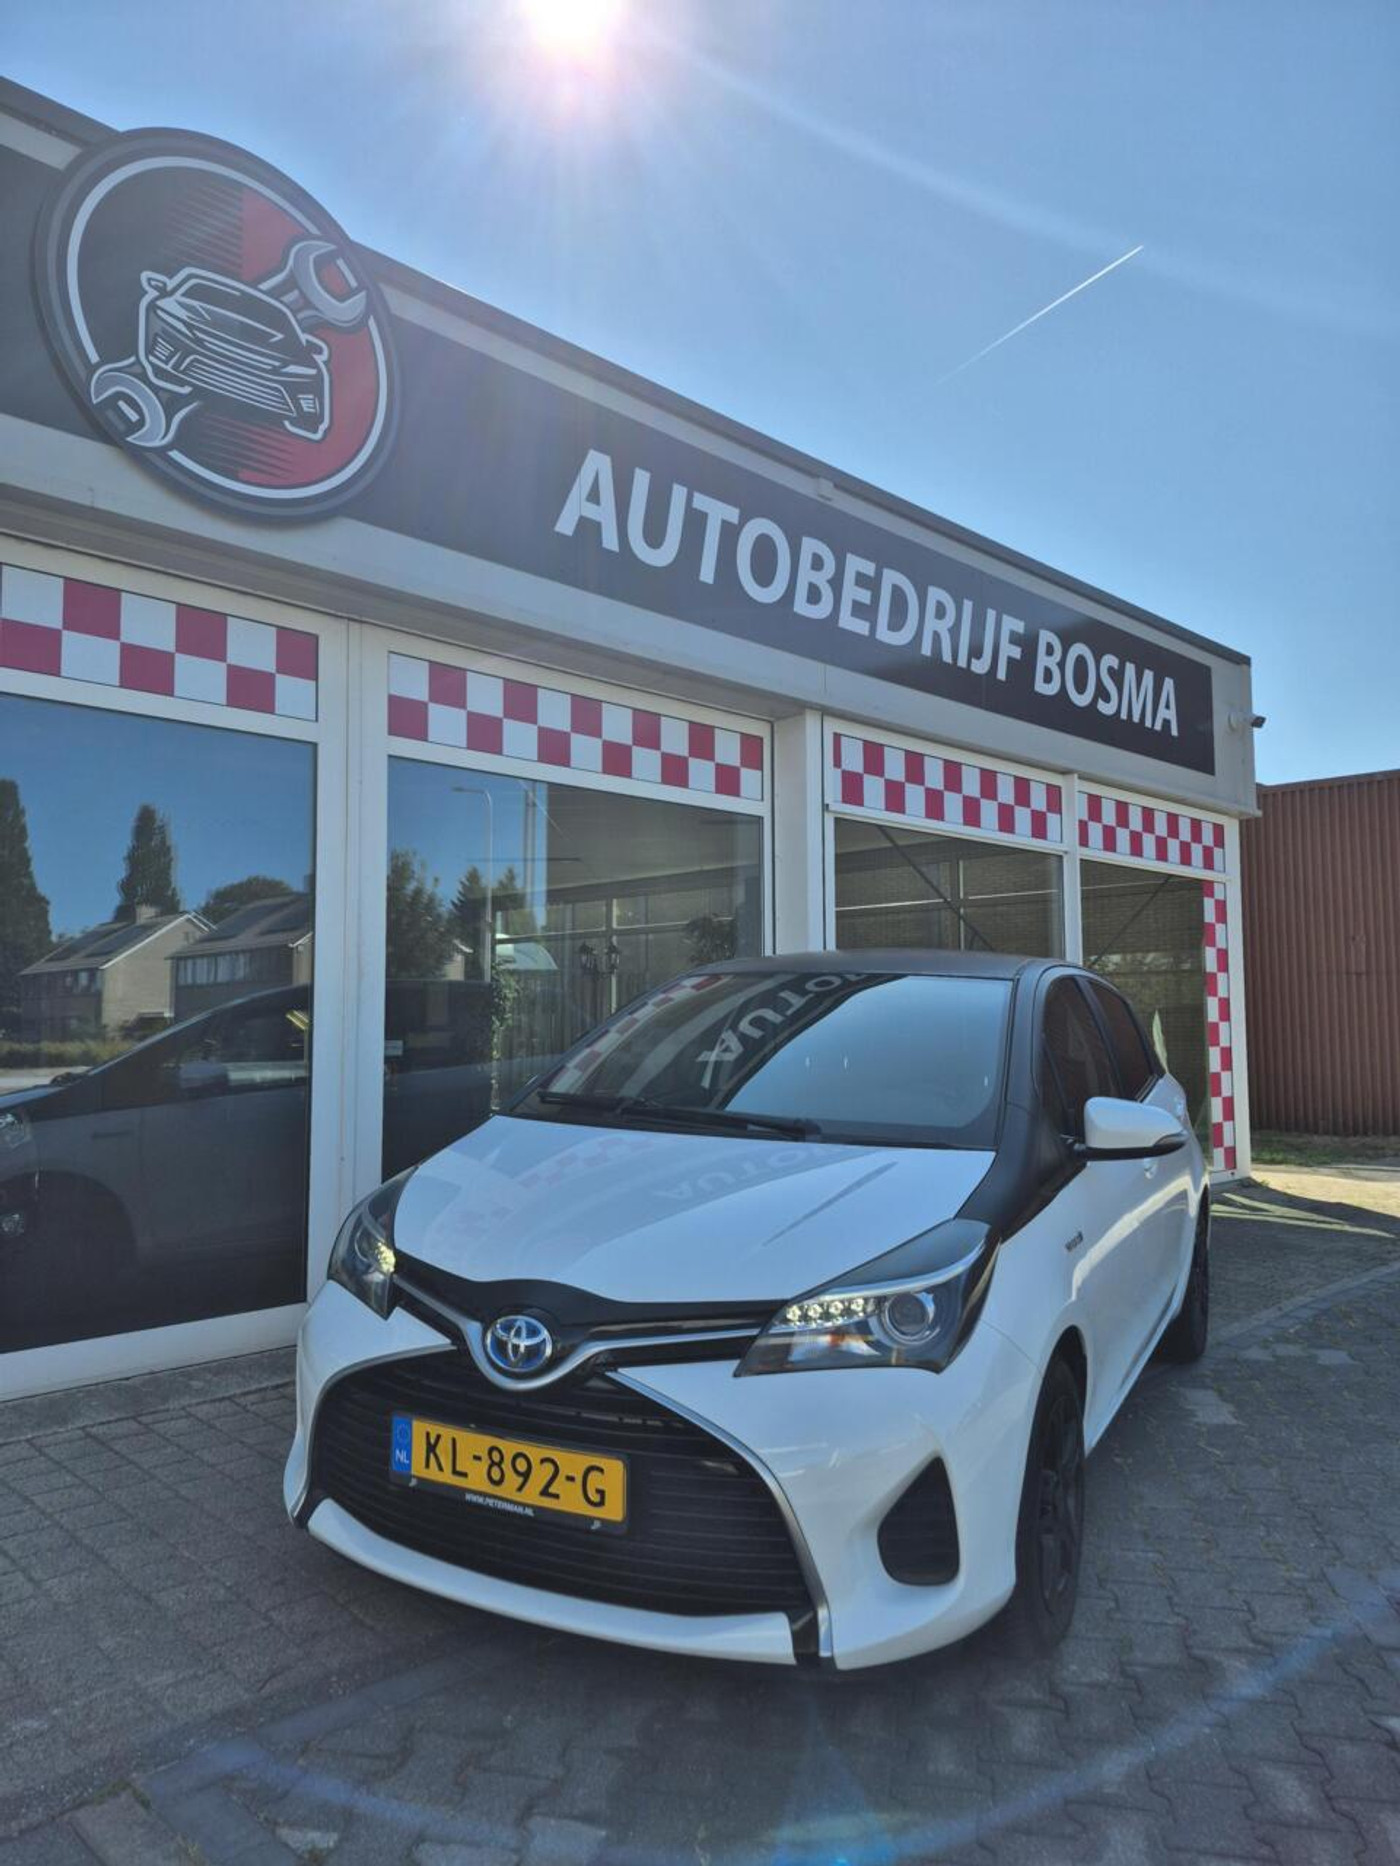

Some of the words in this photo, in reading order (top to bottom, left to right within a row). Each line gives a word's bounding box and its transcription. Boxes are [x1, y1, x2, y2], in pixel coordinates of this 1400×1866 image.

[554, 449, 1025, 681] AUTOBEDRIJF
[1034, 629, 1178, 737] BOSMA
[395, 1448, 410, 1465] NL
[424, 1431, 606, 1508] KL-892-G
